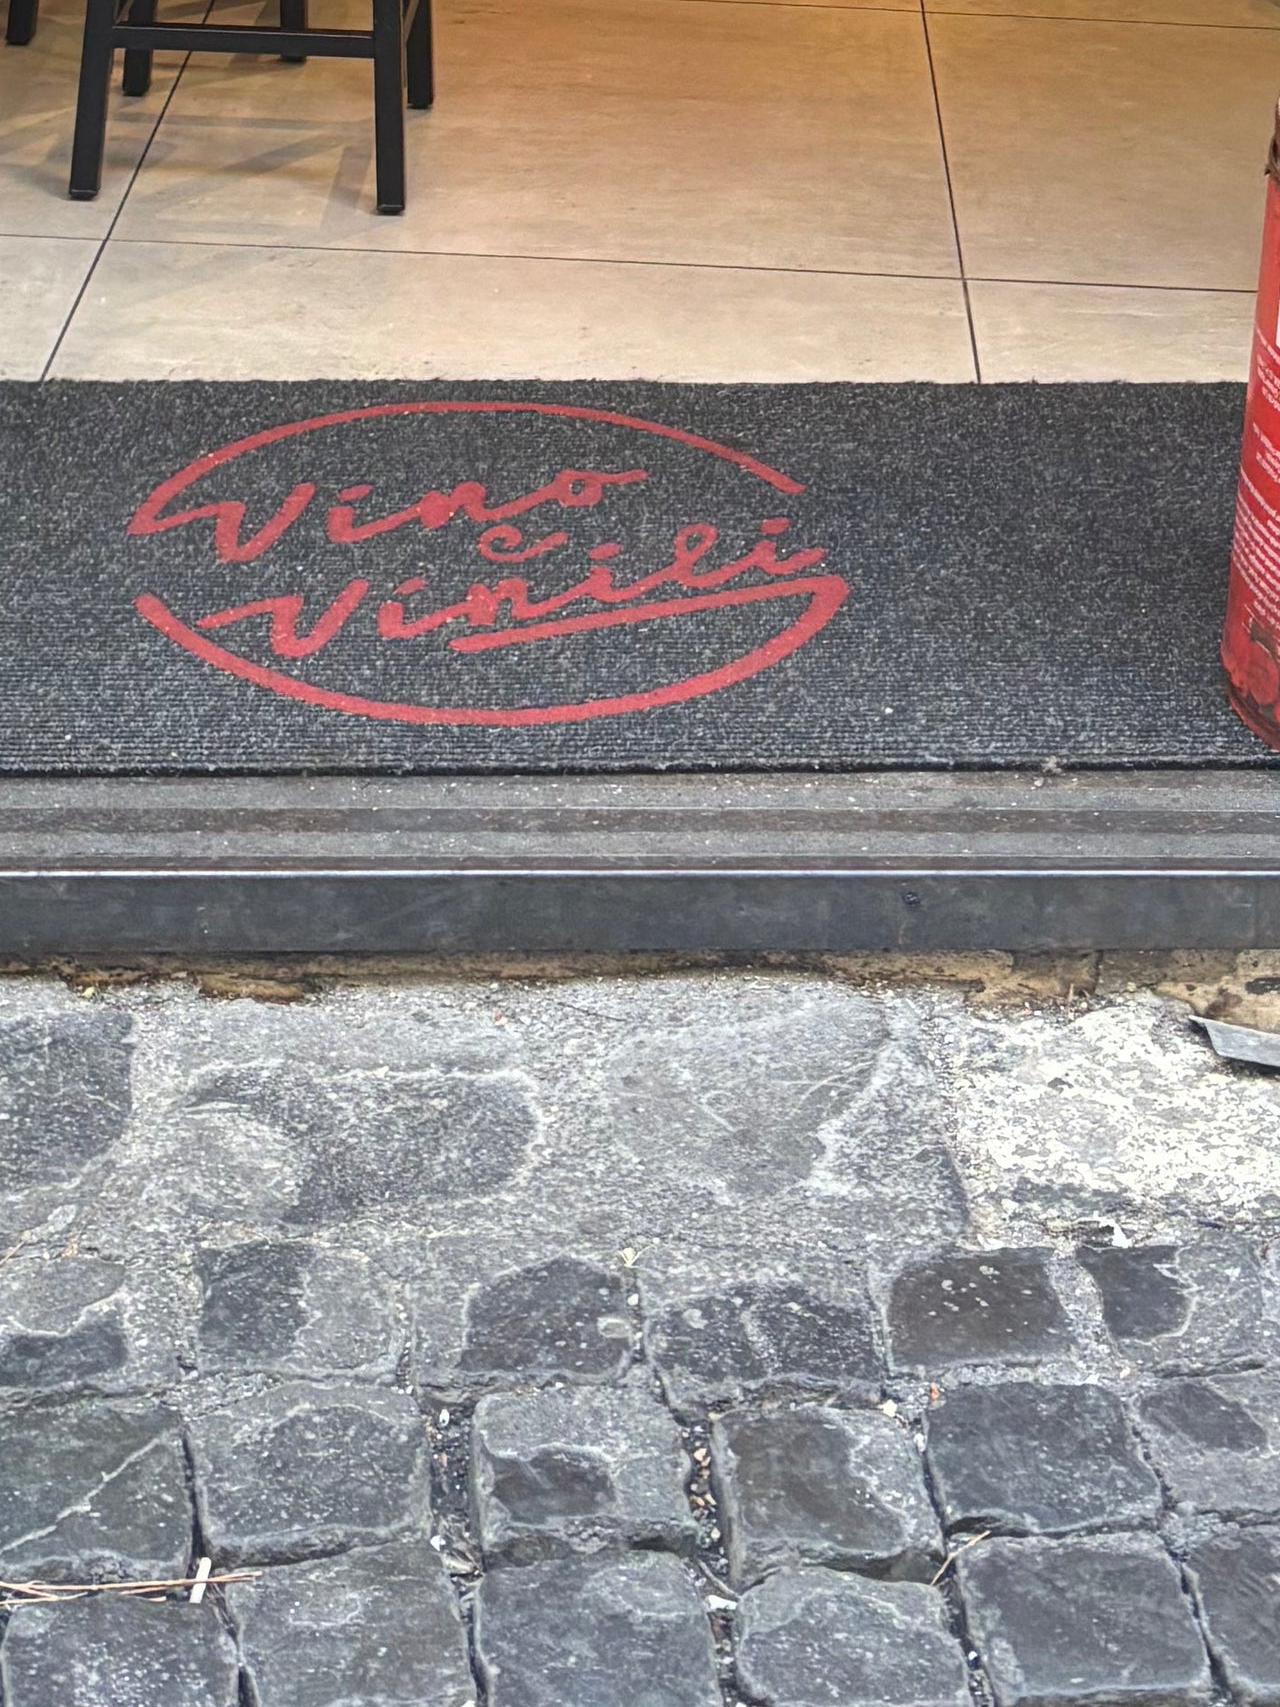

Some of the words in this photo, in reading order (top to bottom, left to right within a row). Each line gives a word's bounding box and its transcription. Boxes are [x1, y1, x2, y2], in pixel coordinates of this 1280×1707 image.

[130, 469, 649, 563] Vino
[477, 525, 567, 562] e
[195, 517, 825, 658] Vinili
